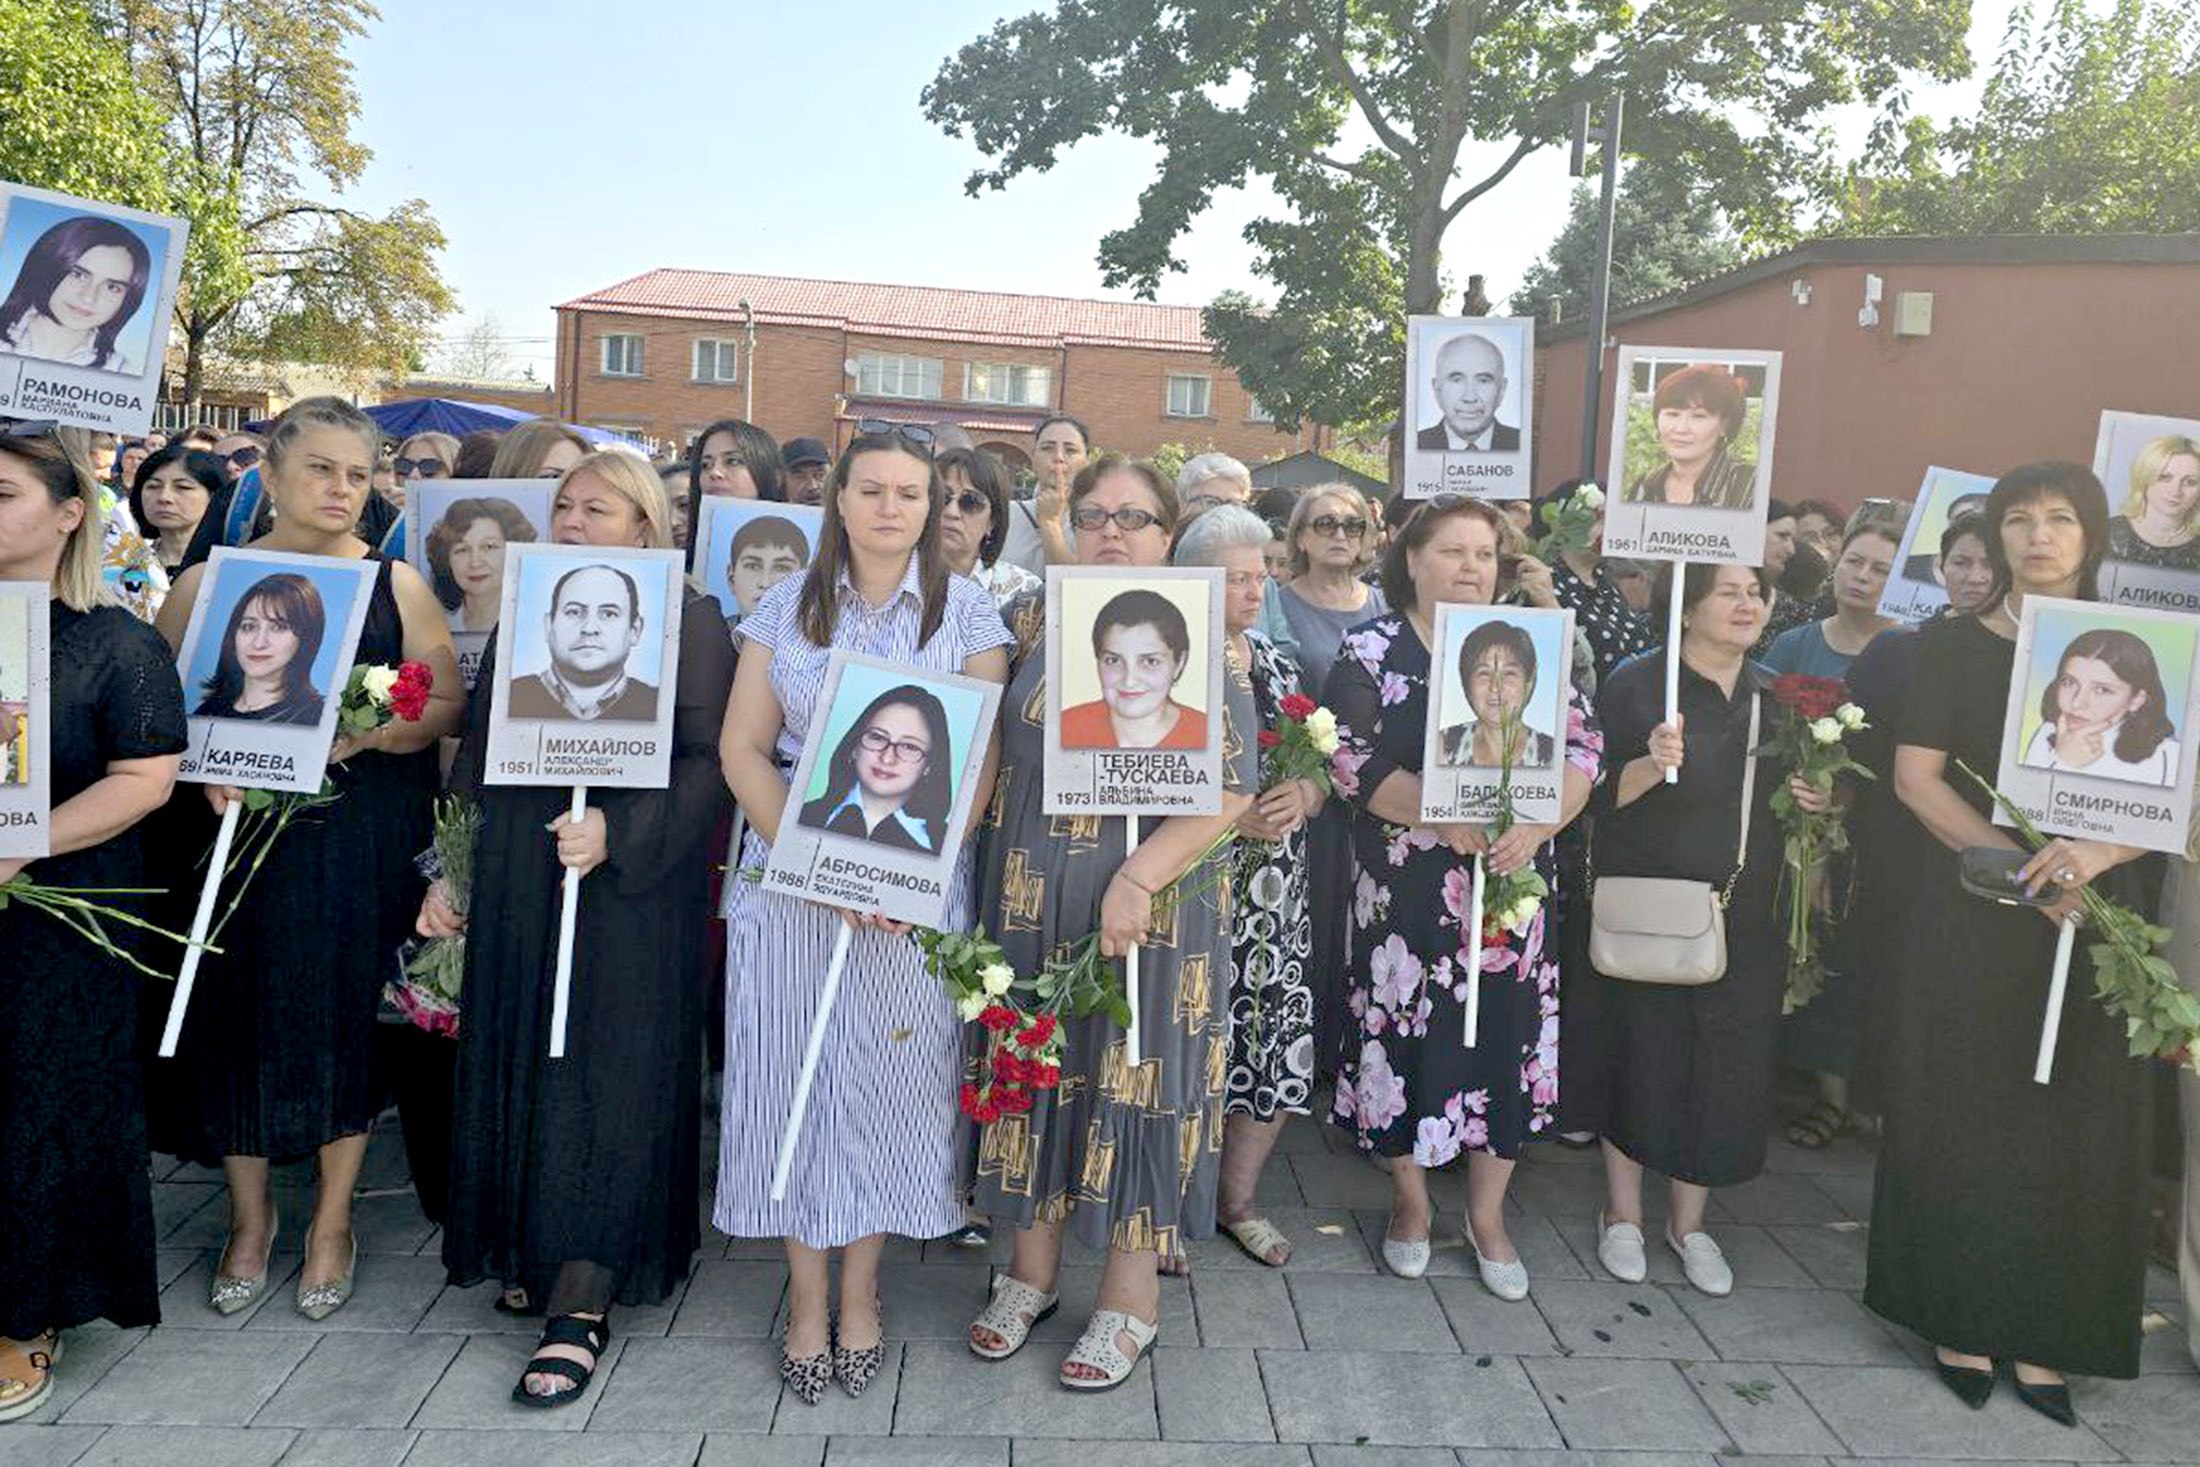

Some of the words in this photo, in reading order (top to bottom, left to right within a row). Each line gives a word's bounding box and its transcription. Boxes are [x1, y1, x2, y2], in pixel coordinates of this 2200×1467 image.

[23, 378, 143, 411] РАМОНОВА
[1446, 465, 1514, 477] САБАНОВ
[1649, 531, 1731, 549] АЛИКОВА
[2119, 586, 2200, 609] АЛИКОВ
[546, 738, 656, 756] МИХАЙЛОВ
[179, 759, 197, 772] 69
[207, 749, 294, 771] КАРЯЕВА
[499, 762, 533, 774] 1951
[1099, 754, 1189, 769] ТЕБИЕВА
[1099, 769, 1209, 785] -ТУСКАЕВА
[1057, 793, 1091, 805] 1973
[1099, 786, 1153, 795] АЛЬБИНА
[2055, 791, 2173, 822] СМИРНОВА
[769, 869, 805, 888] 1988
[819, 856, 942, 897] АБРОСИМОВА
